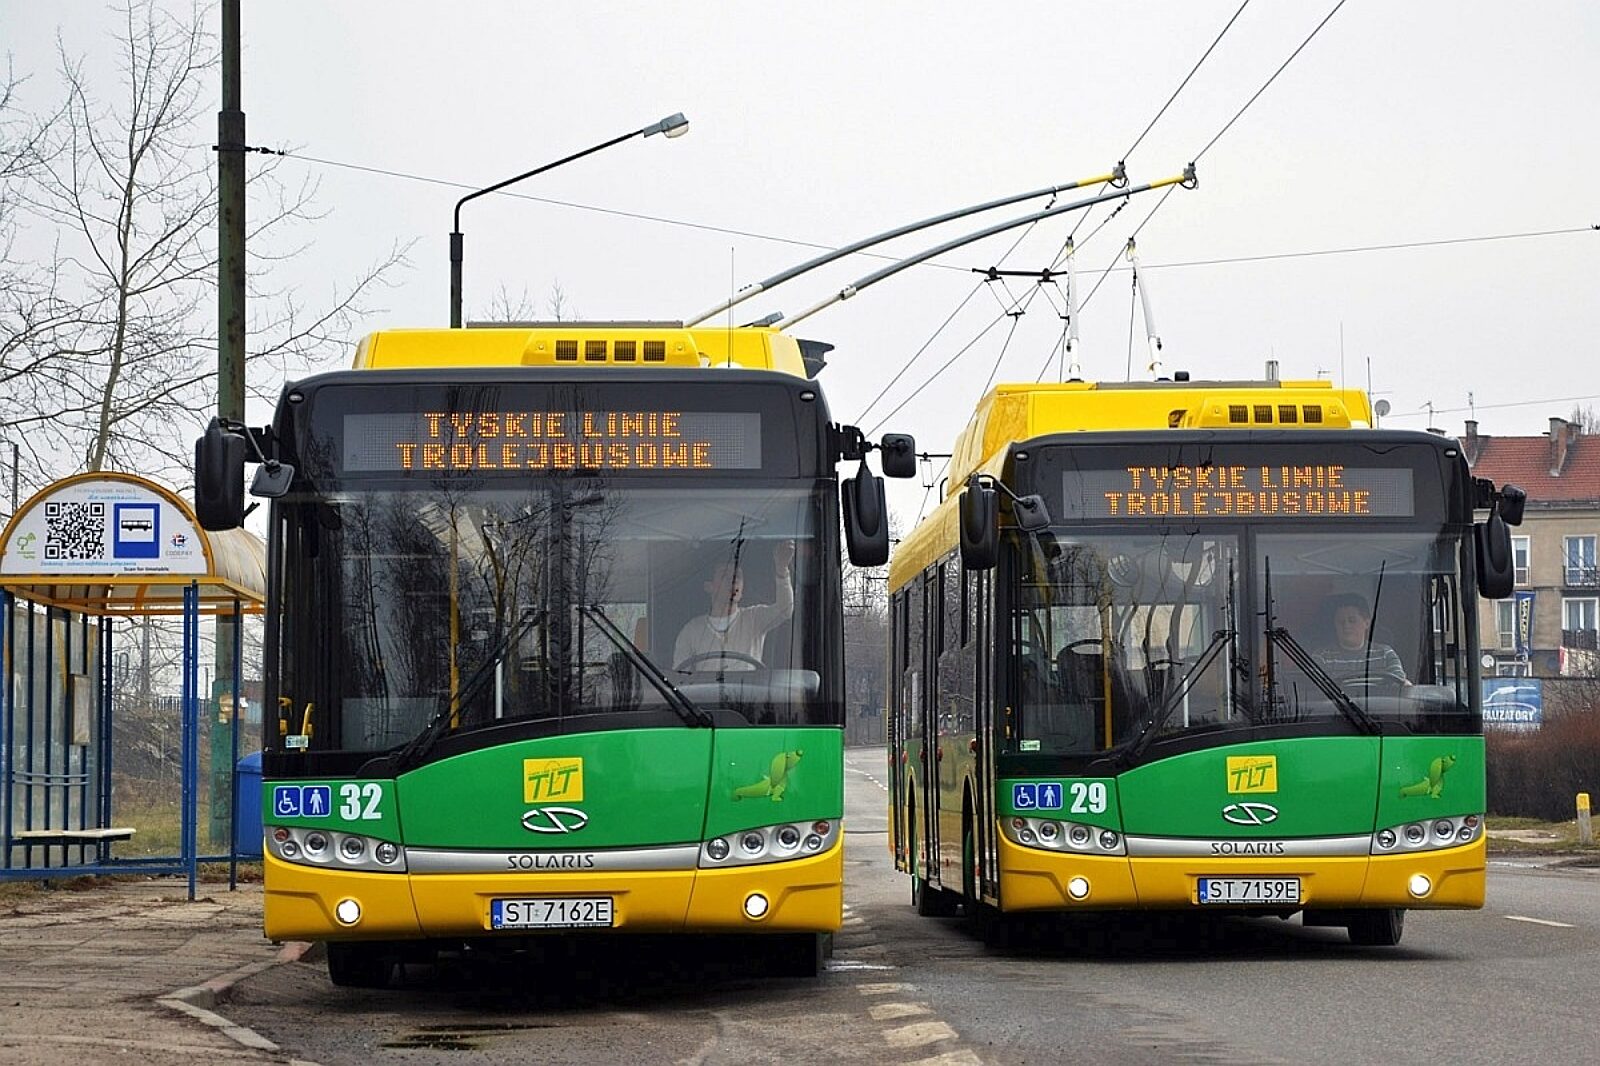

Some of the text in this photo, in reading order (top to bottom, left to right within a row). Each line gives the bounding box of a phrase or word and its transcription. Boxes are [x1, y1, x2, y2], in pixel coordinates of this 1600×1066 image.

[425, 411, 681, 438] TYSKIE LINIE
[395, 443, 712, 469] TROLEJBUSOWE
[1127, 466, 1345, 489] TYSKIE LINIE
[1104, 491, 1371, 515] TROLEJBUSOWE
[528, 767, 578, 801] TLT
[1231, 764, 1273, 791] TLT
[339, 783, 382, 821] 32
[1070, 782, 1107, 814] 29
[1211, 841, 1285, 855] SOLARIS
[508, 854, 595, 869] SOLARIS
[1211, 881, 1297, 898] ST 7159E
[506, 902, 609, 922] ST 7162E
